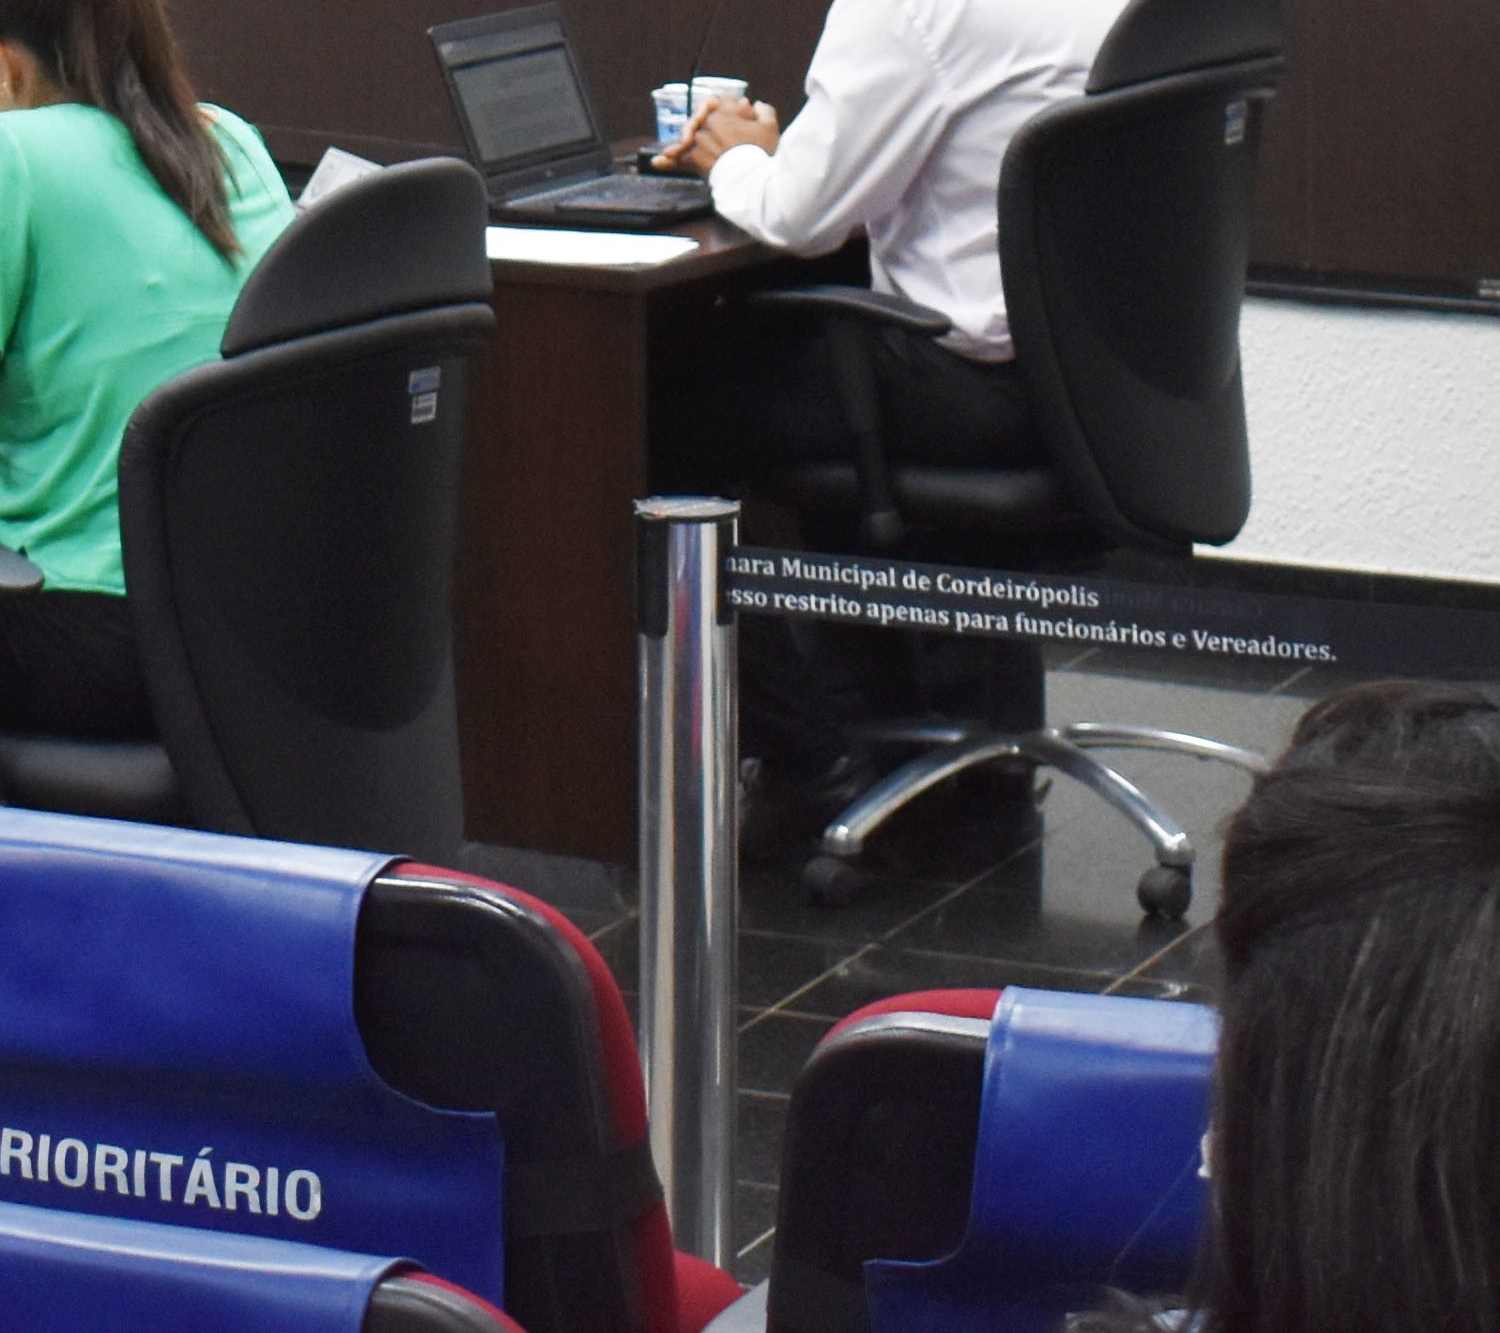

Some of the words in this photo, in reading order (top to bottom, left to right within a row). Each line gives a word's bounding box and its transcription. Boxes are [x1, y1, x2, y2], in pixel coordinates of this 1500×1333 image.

[781, 556, 896, 590] Municipal
[902, 569, 931, 591] de
[937, 572, 1100, 609] Cordeirópolis
[773, 592, 861, 617] restrito
[866, 600, 950, 625] apenas
[955, 609, 1009, 632] para
[1014, 611, 1166, 648] funcionários
[1171, 632, 1187, 649] e
[1191, 629, 1338, 662] Vereadores.
